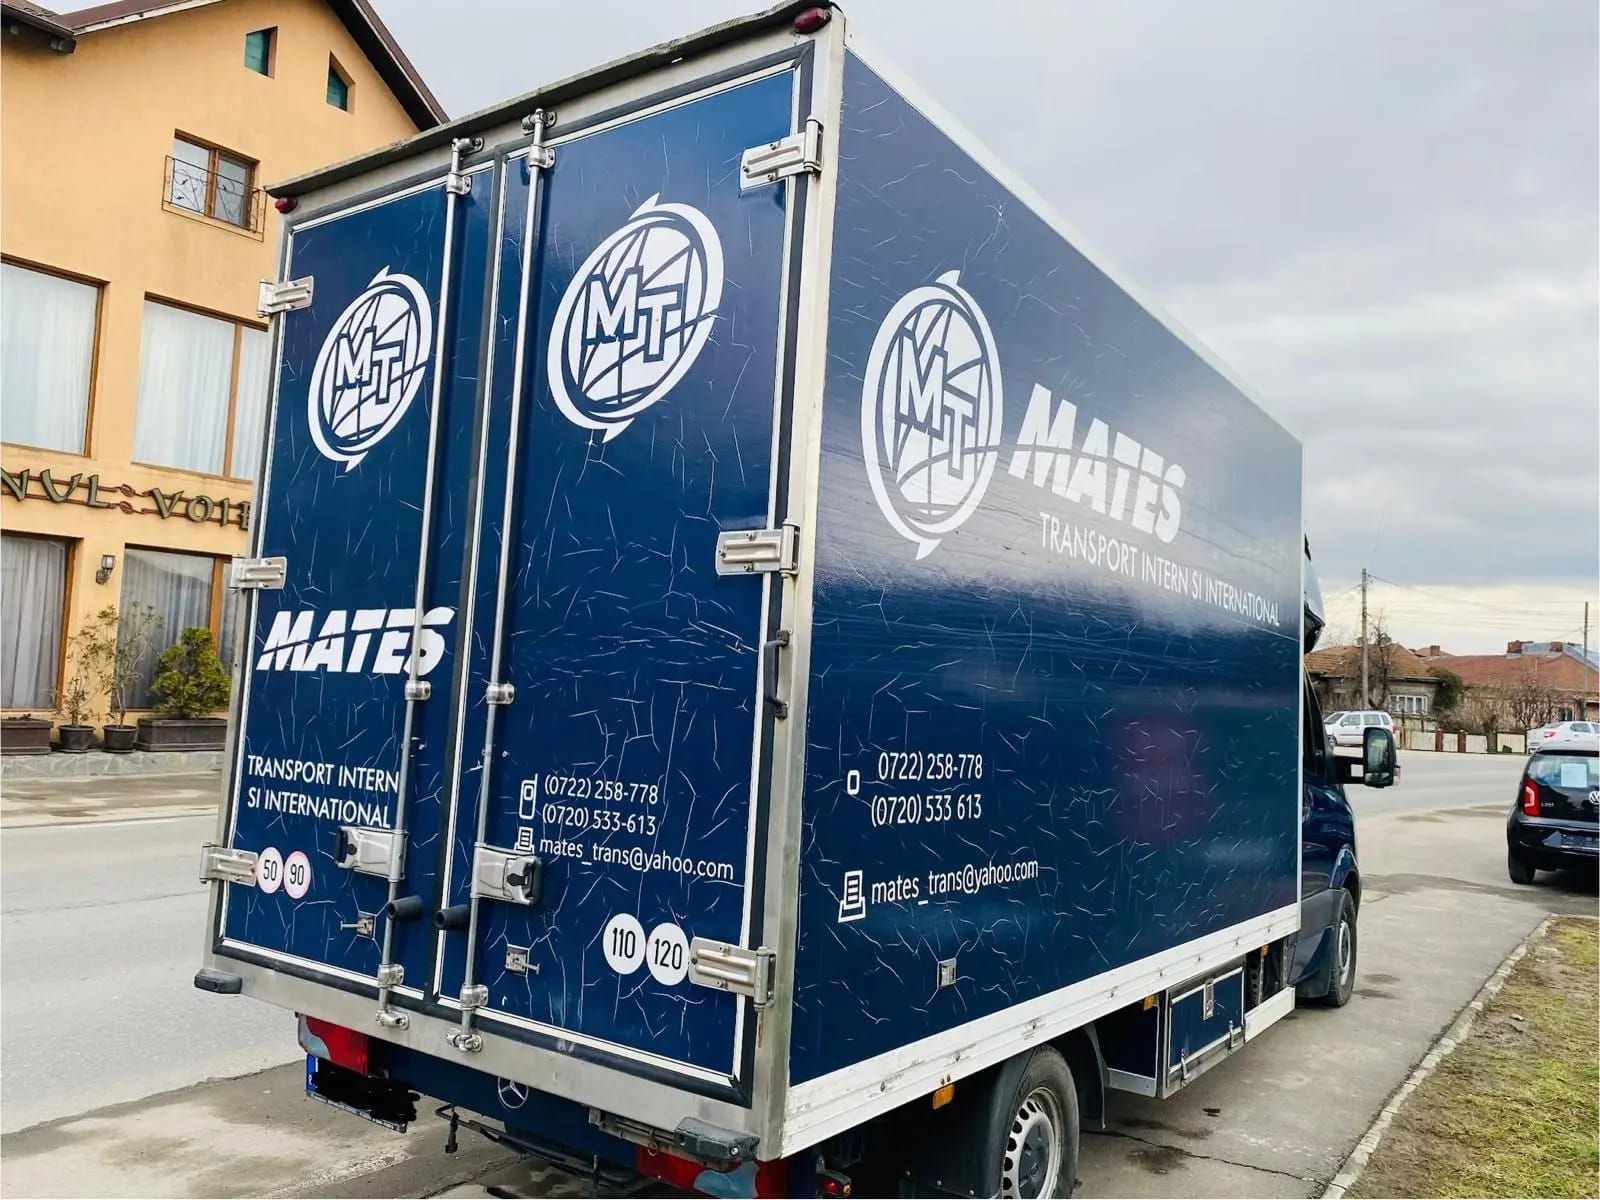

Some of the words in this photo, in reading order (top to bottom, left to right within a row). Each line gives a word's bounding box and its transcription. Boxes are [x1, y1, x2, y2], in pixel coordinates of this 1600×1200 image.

[1007, 383, 1187, 544] MATES
[1039, 511, 1138, 577] TRANSPORT
[1141, 551, 1189, 596] INTERN
[1191, 571, 1202, 601] SI
[1205, 578, 1281, 627] INTERNATIONAL
[255, 606, 455, 676] MATES
[247, 754, 335, 785] TRANSPORT
[338, 765, 400, 793] INTERN
[877, 750, 924, 781] 0722)
[926, 753, 983, 780] 258-778
[544, 773, 592, 800] (0722)
[594, 780, 659, 805] 258-778
[247, 786, 261, 809] SI
[264, 789, 391, 829] INTERNATIONAL
[541, 803, 590, 829] (0720)
[592, 810, 657, 836] 533-613
[871, 794, 922, 828] (0720)
[925, 795, 952, 823] 533
[957, 794, 983, 820] 613
[262, 859, 278, 882] 50
[289, 864, 305, 886] 90
[539, 838, 735, 880] mates_trans@yahoo.com
[870, 859, 1040, 906] mates_trans@yahoo.com
[611, 927, 637, 960] 110
[654, 938, 683, 971] 120
